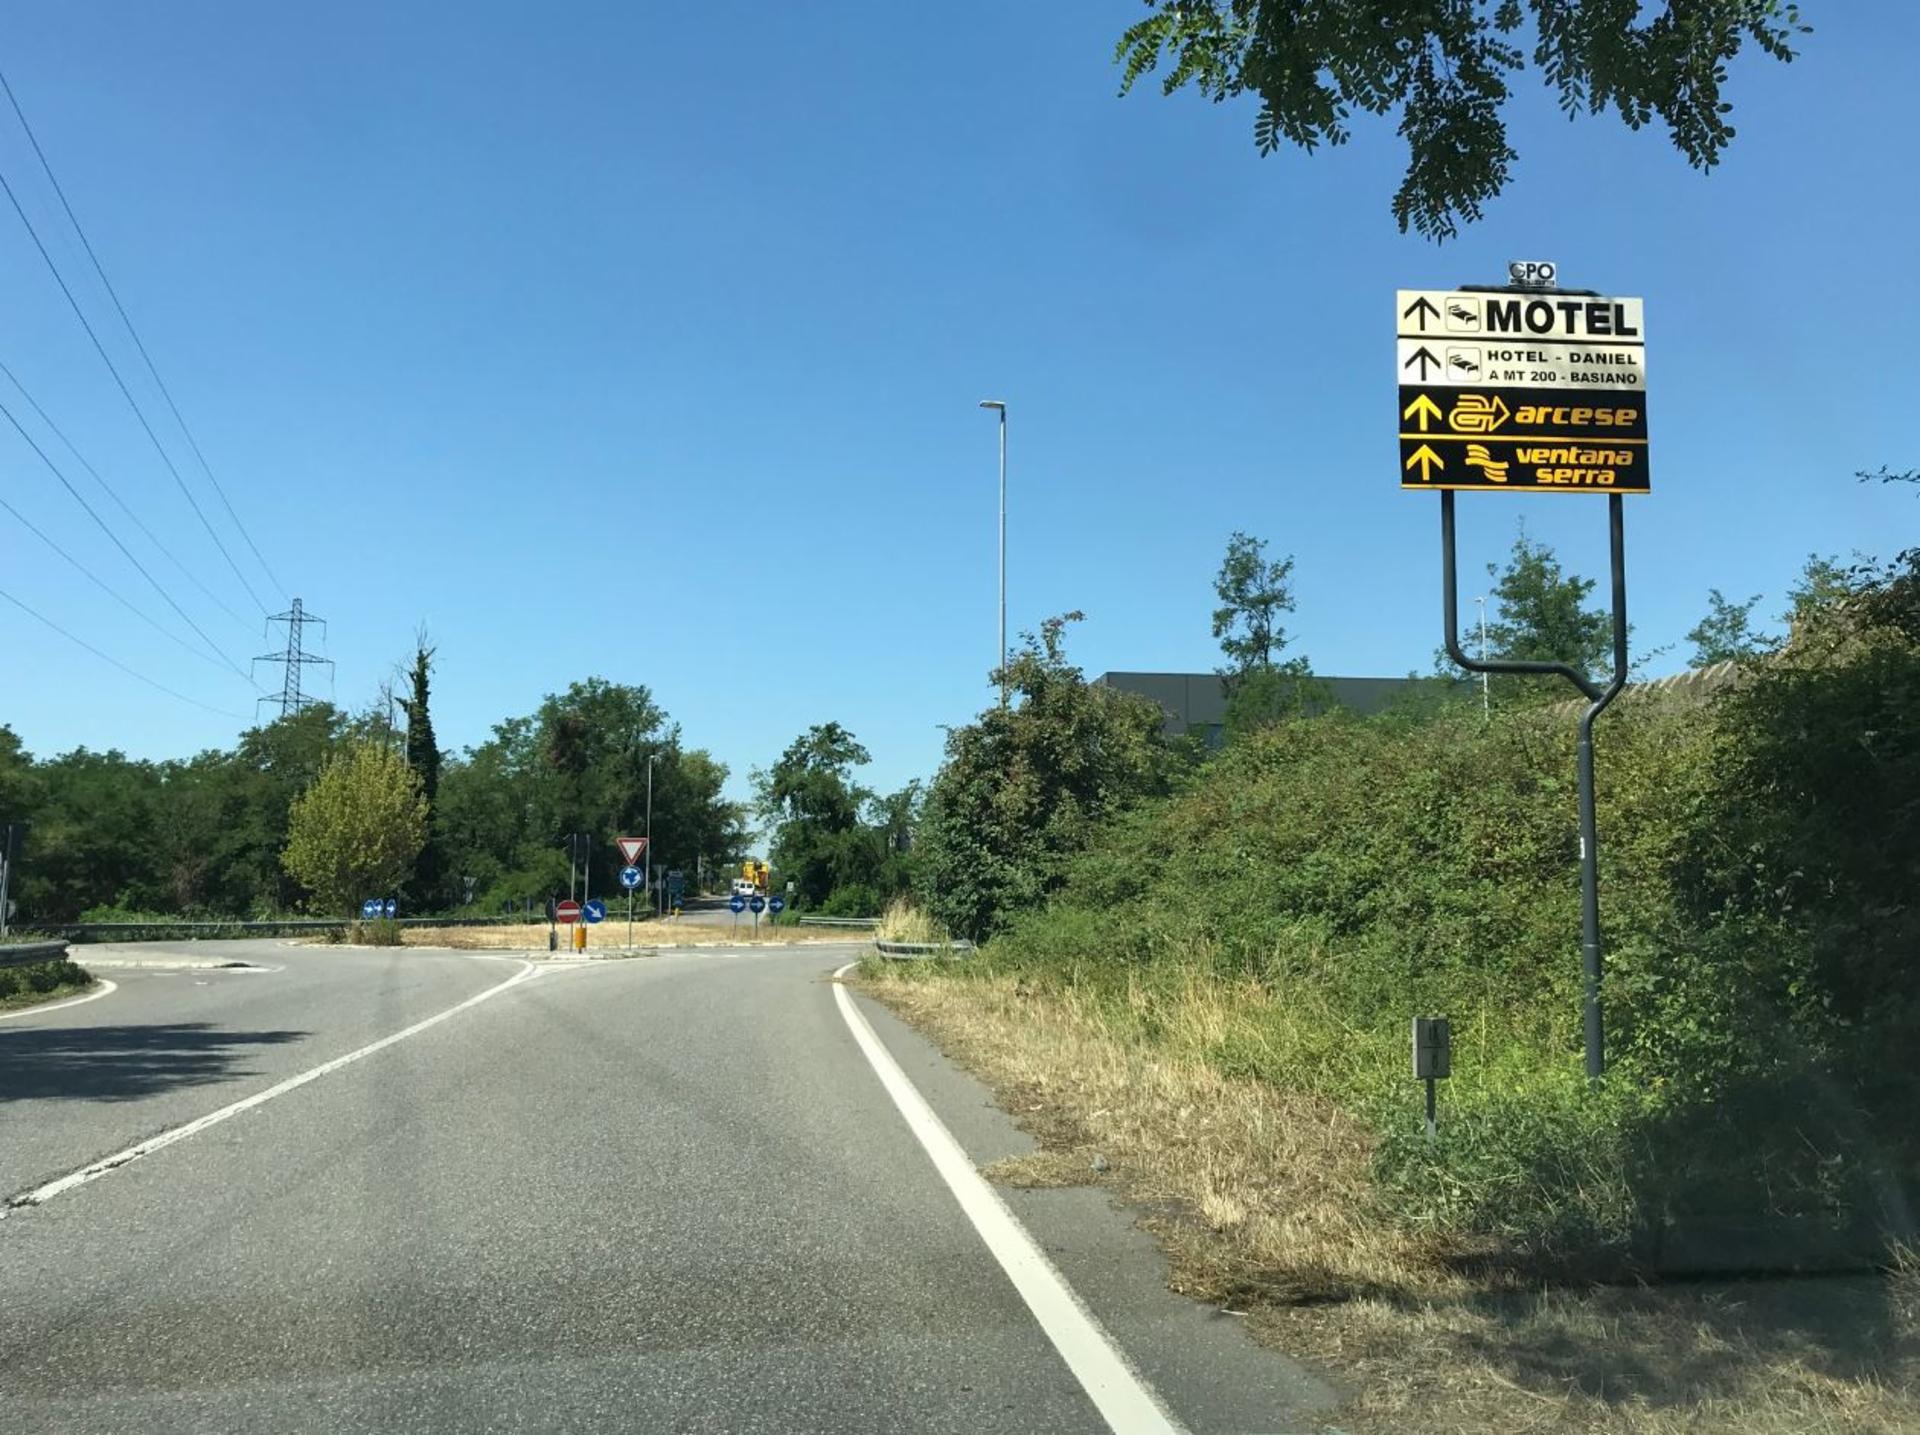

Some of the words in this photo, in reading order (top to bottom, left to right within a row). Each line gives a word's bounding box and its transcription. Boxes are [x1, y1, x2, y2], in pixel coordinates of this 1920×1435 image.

[1487, 300, 1637, 336] MOTEL
[1488, 350, 1548, 362] HOTEL
[1570, 353, 1637, 365] DANIEL
[1489, 371, 1499, 380] A
[1504, 371, 1525, 381] MT
[1531, 372, 1556, 382] 200
[1571, 373, 1637, 384] BASIANO
[1515, 405, 1637, 425] arcese
[1516, 447, 1633, 465] ventana
[1536, 468, 1615, 484] serra
